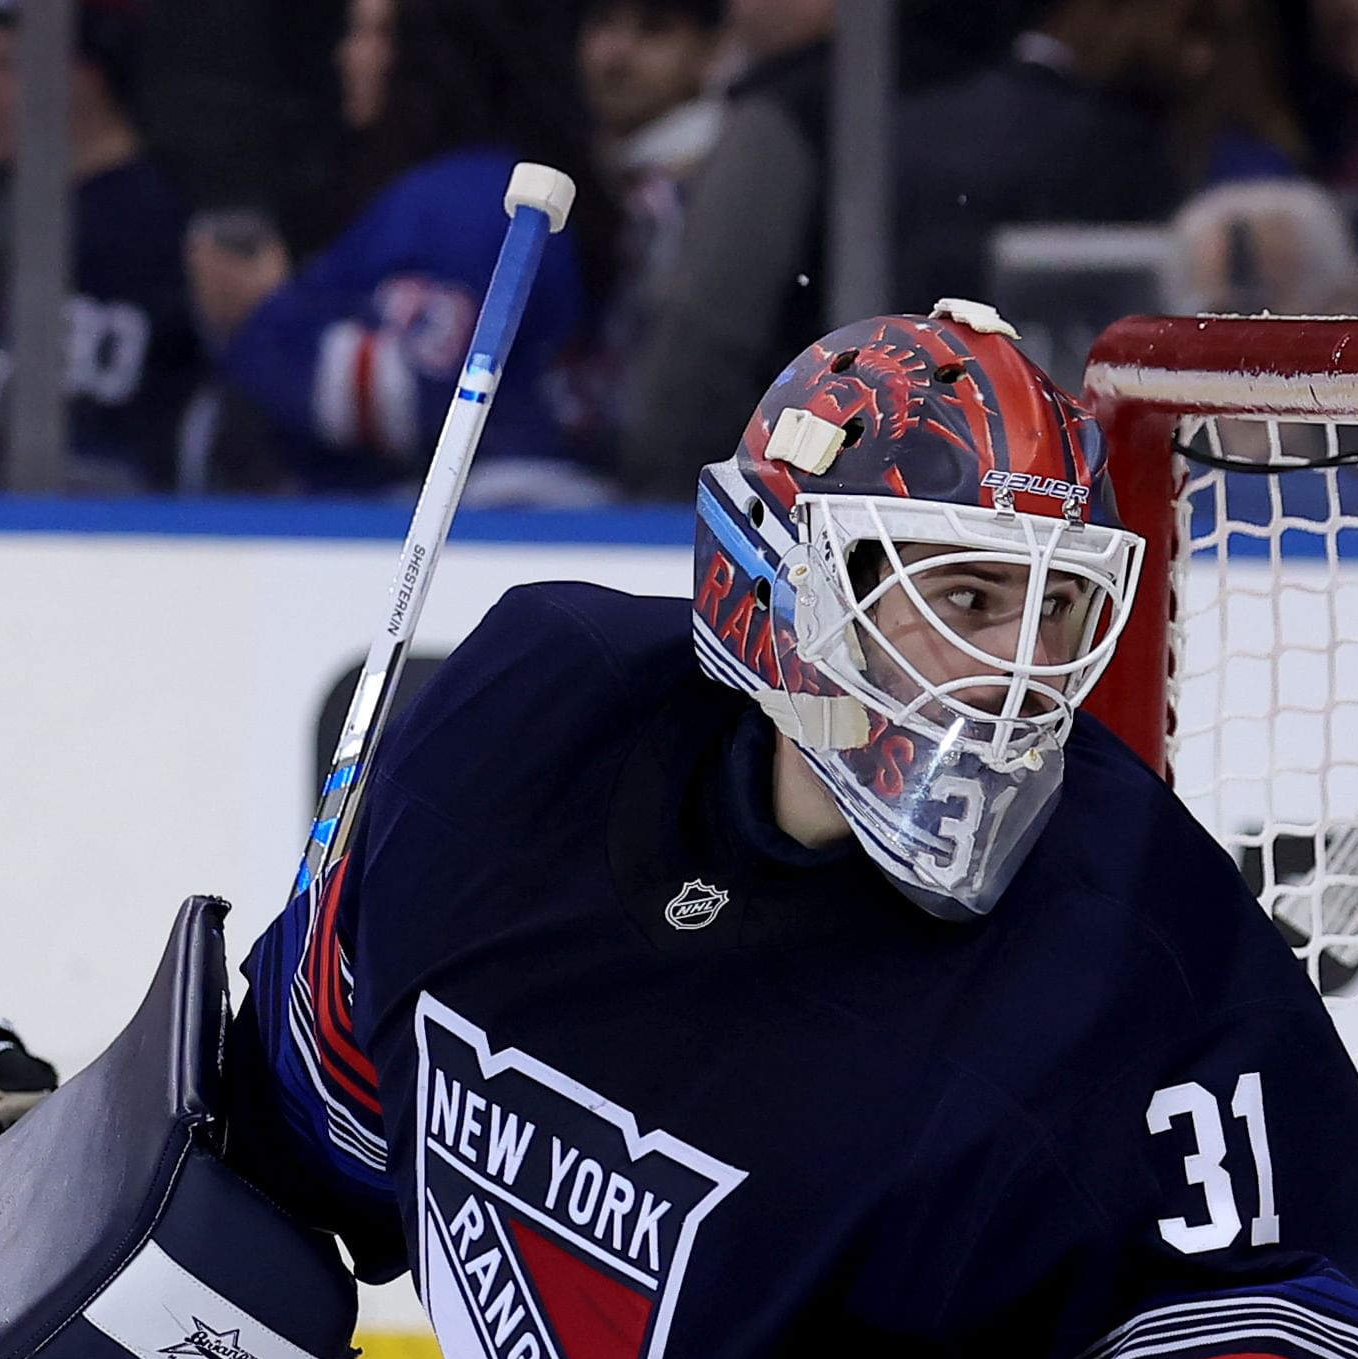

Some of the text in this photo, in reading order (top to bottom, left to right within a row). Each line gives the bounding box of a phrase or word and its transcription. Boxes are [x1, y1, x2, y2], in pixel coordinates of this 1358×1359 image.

[981, 470, 1089, 504] BAUER
[387, 543, 426, 637] SHESTERKIN
[913, 773, 1018, 893] 31
[675, 900, 714, 917] NHL
[431, 1067, 674, 1271] NEW YORK
[1146, 1072, 1280, 1254] 31
